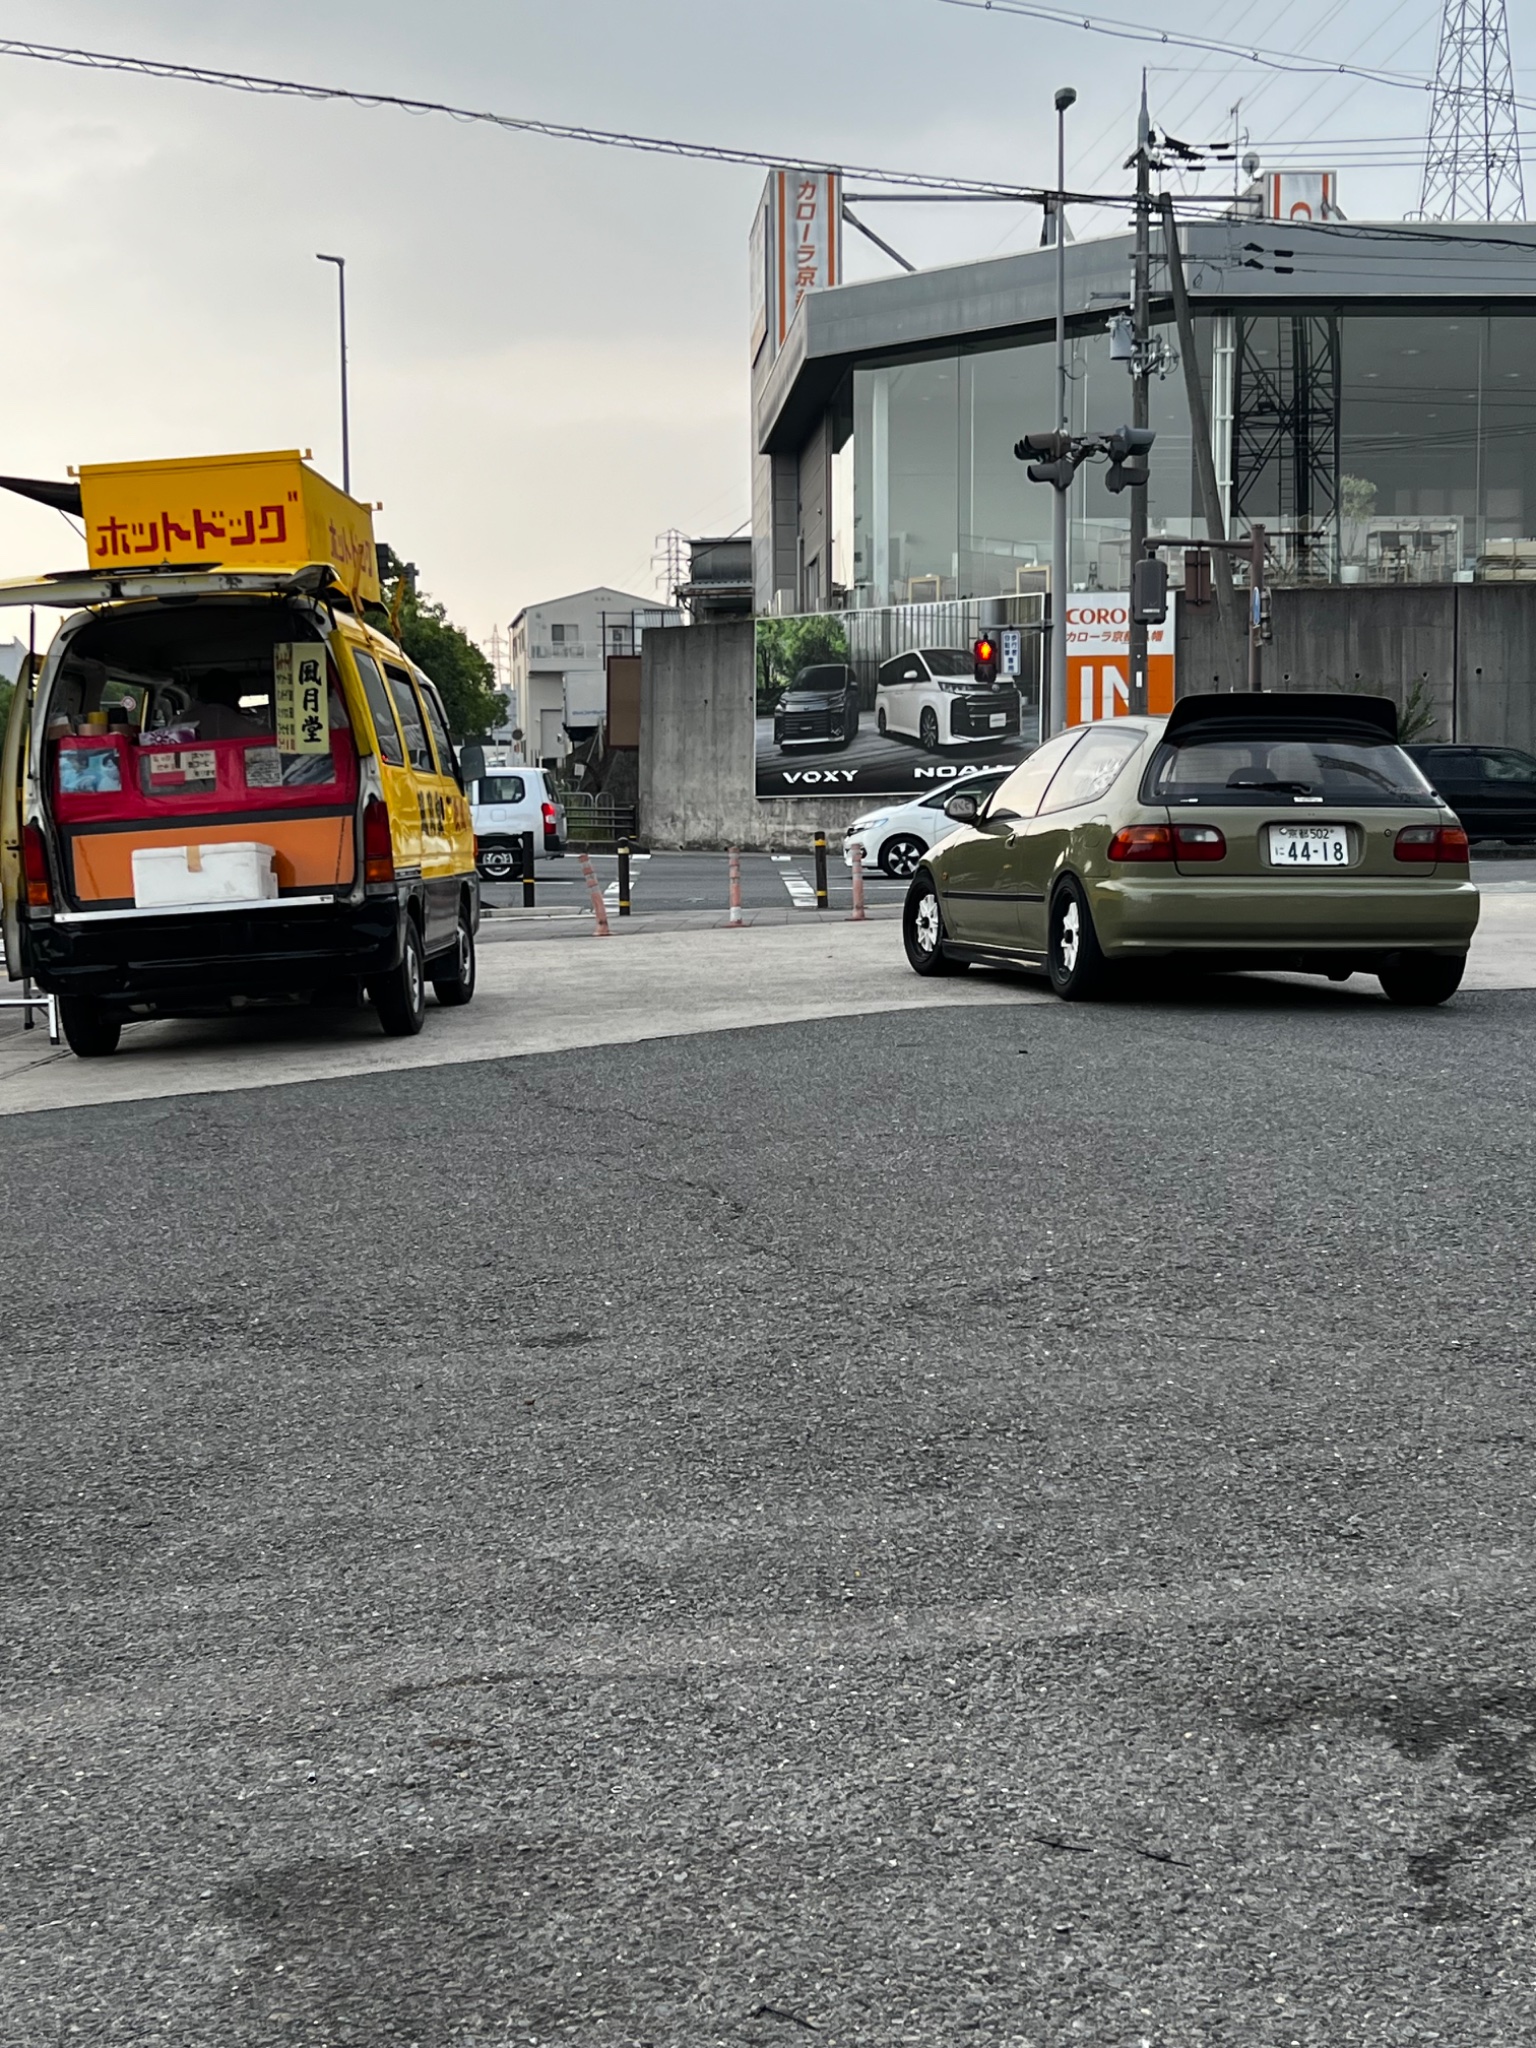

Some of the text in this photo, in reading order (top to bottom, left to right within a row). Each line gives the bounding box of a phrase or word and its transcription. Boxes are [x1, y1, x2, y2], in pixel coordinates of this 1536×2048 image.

[95, 491, 298, 557] ホットドッグ
[1066, 608, 1127, 625] CORO
[1066, 630, 1164, 643] カローラ京幡
[299, 659, 323, 743] 風月堂
[1080, 665, 1130, 722] IN
[783, 770, 859, 784] VOXY
[1288, 841, 1344, 862] 44-18
